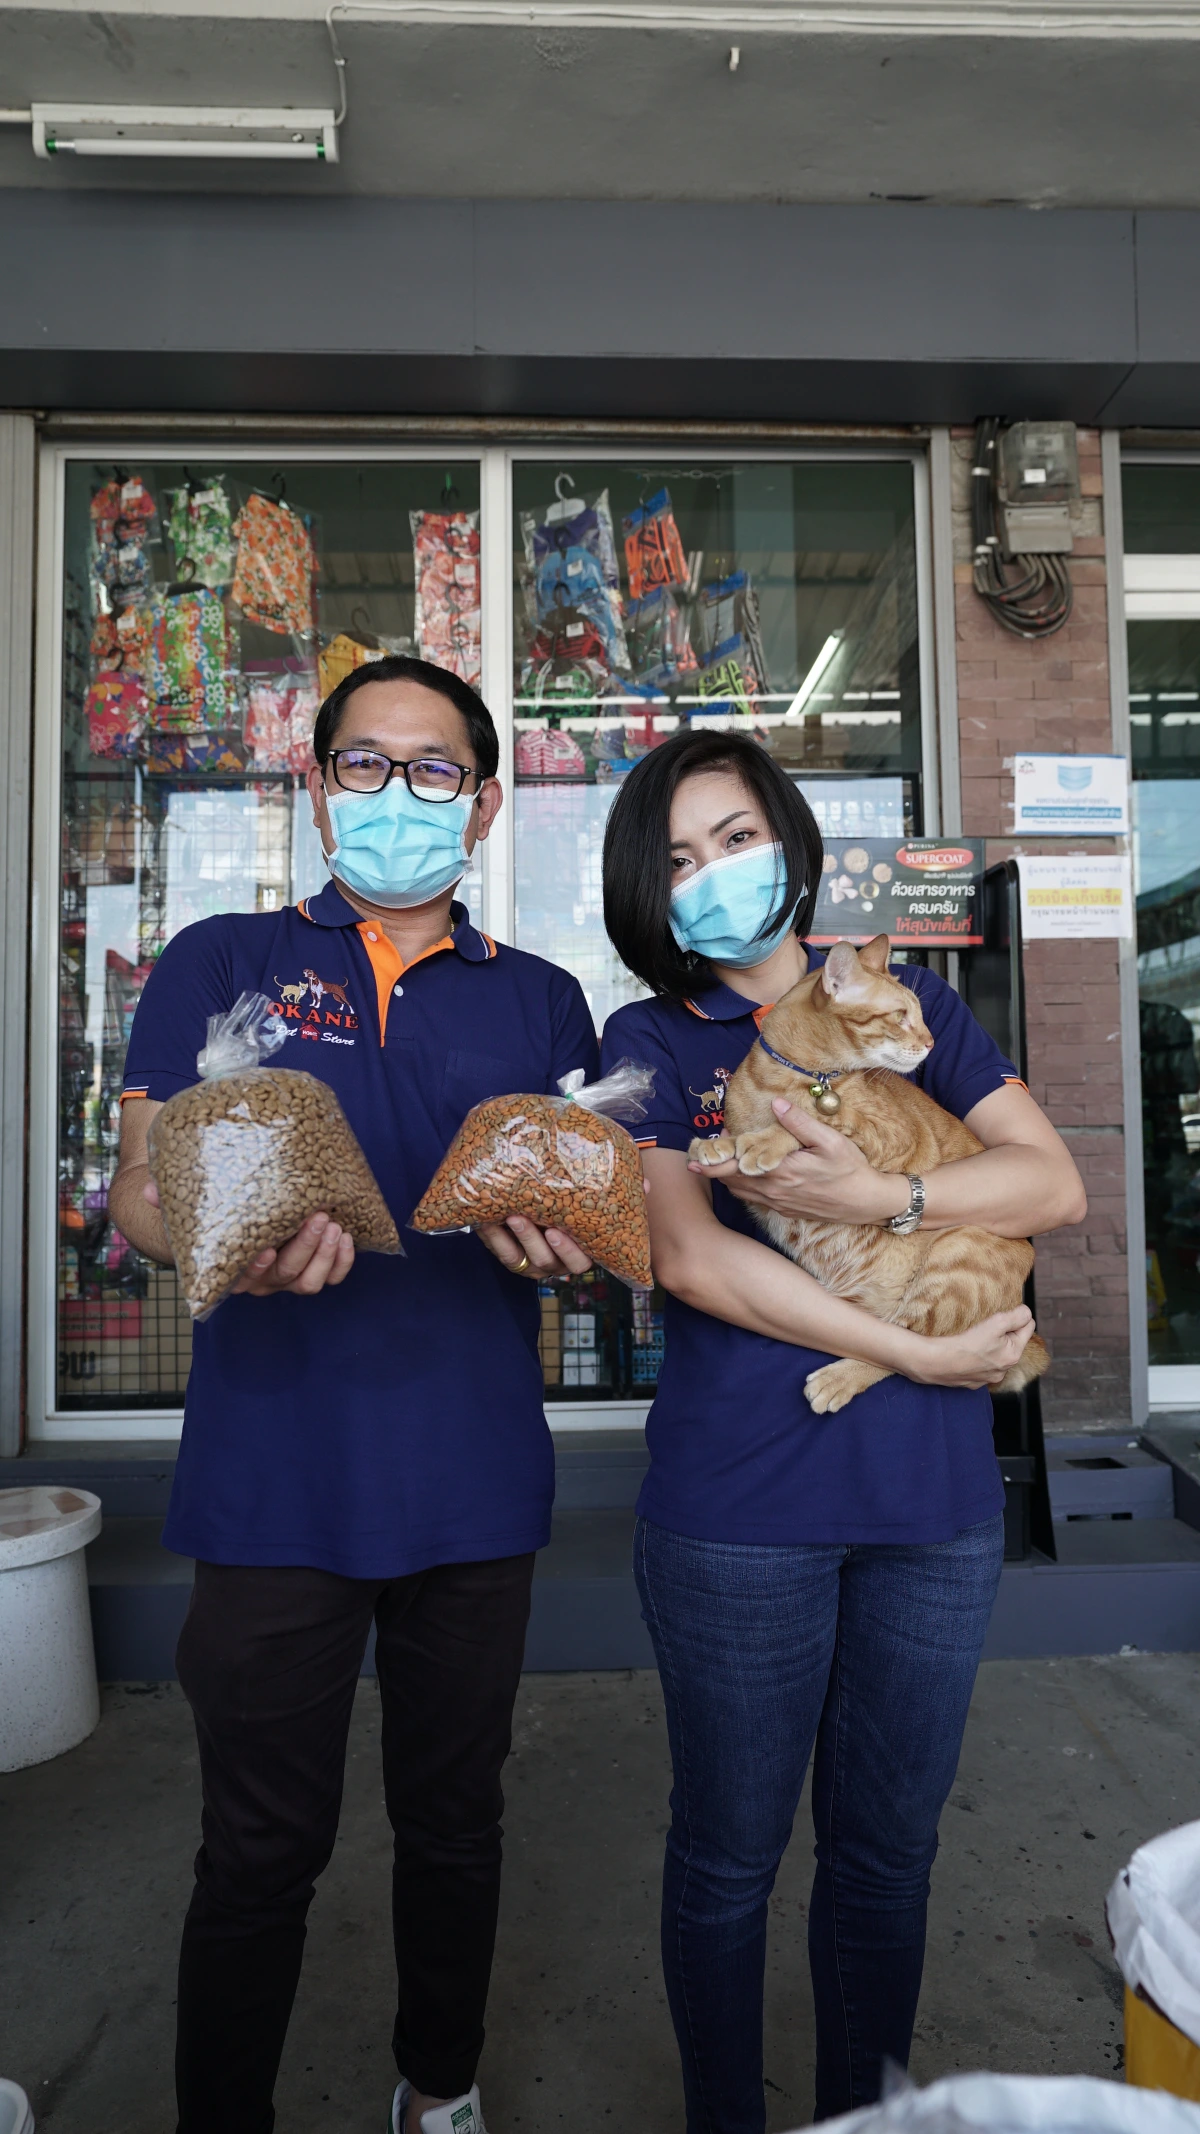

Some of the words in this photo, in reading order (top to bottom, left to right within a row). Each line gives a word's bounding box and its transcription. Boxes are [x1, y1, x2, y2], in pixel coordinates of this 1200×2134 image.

[905, 853, 965, 865] SUPERCOAT
[890, 881, 976, 897] ด้วยสารอาหาร
[908, 900, 959, 914] ครบครัน
[895, 915, 972, 935] ให้สุนัขเต็มที่
[266, 1001, 360, 1029] OKANE
[320, 1032, 355, 1046] Store
